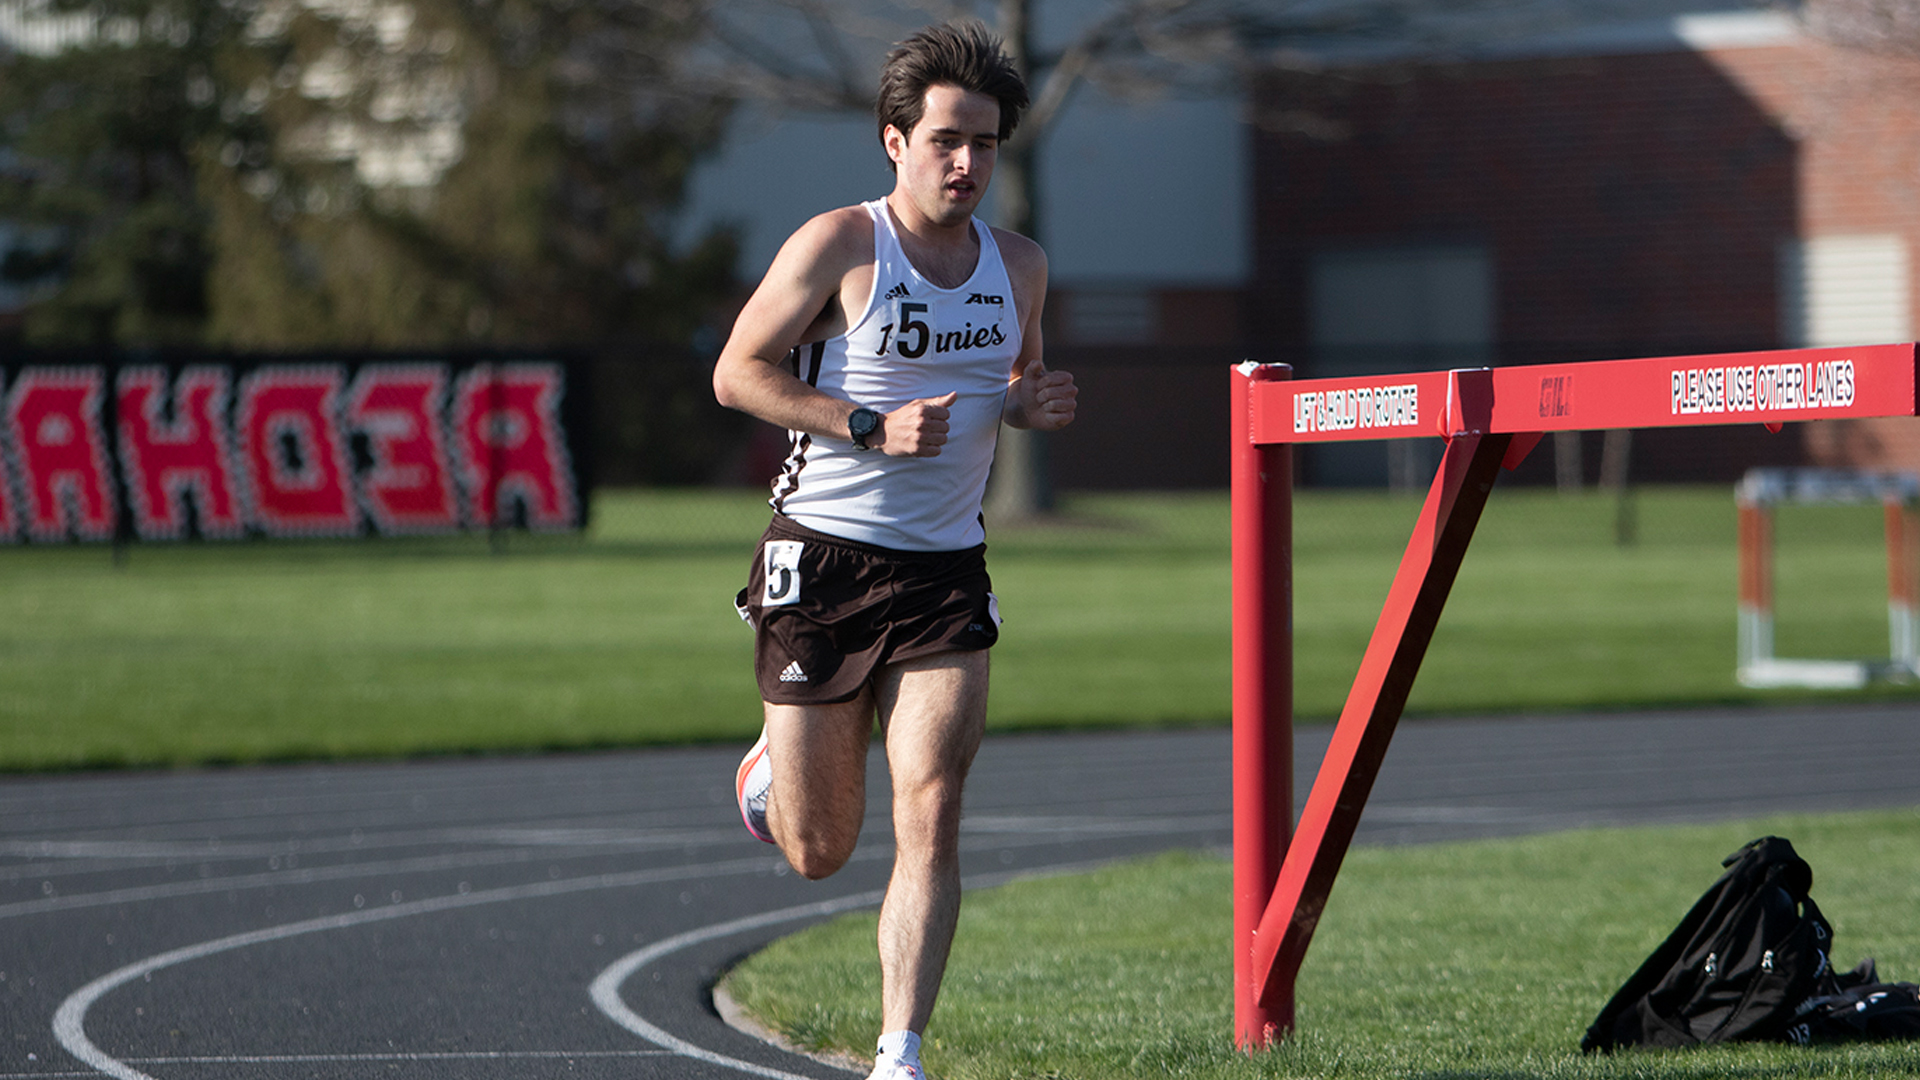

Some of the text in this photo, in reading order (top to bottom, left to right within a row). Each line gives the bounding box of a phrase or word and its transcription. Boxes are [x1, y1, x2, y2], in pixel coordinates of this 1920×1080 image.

[897, 302, 930, 359] 5
[1294, 384, 1418, 433] LIFT & HOLD TO ROTATE
[1672, 359, 1855, 415] PLEASE USE OTHER LANES
[769, 545, 792, 600] 5
